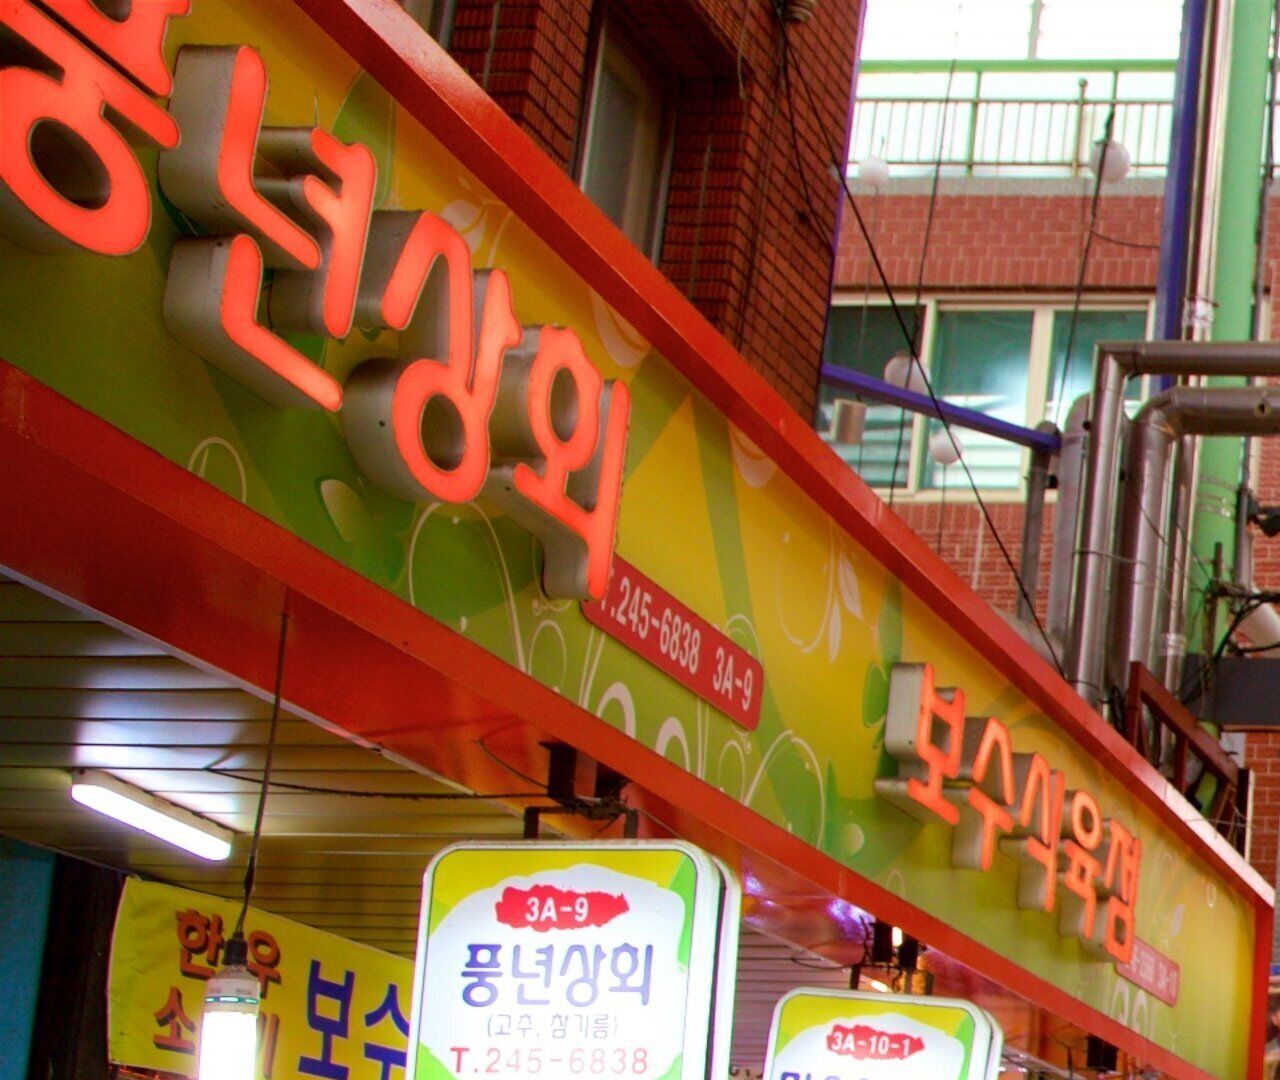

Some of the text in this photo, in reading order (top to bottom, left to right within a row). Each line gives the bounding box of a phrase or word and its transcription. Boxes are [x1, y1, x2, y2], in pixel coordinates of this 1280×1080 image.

[0, 0, 629, 600] 풍년상회
[713, 646, 753, 712] 3A-9
[906, 662, 1143, 966] 보수식육점
[524, 896, 589, 923] 3A-9
[176, 909, 282, 1000] 한우
[460, 942, 652, 1008] 풍년상회
[450, 1046, 649, 1075] T.245-6838
[831, 1030, 911, 1058] 3A-10-1
